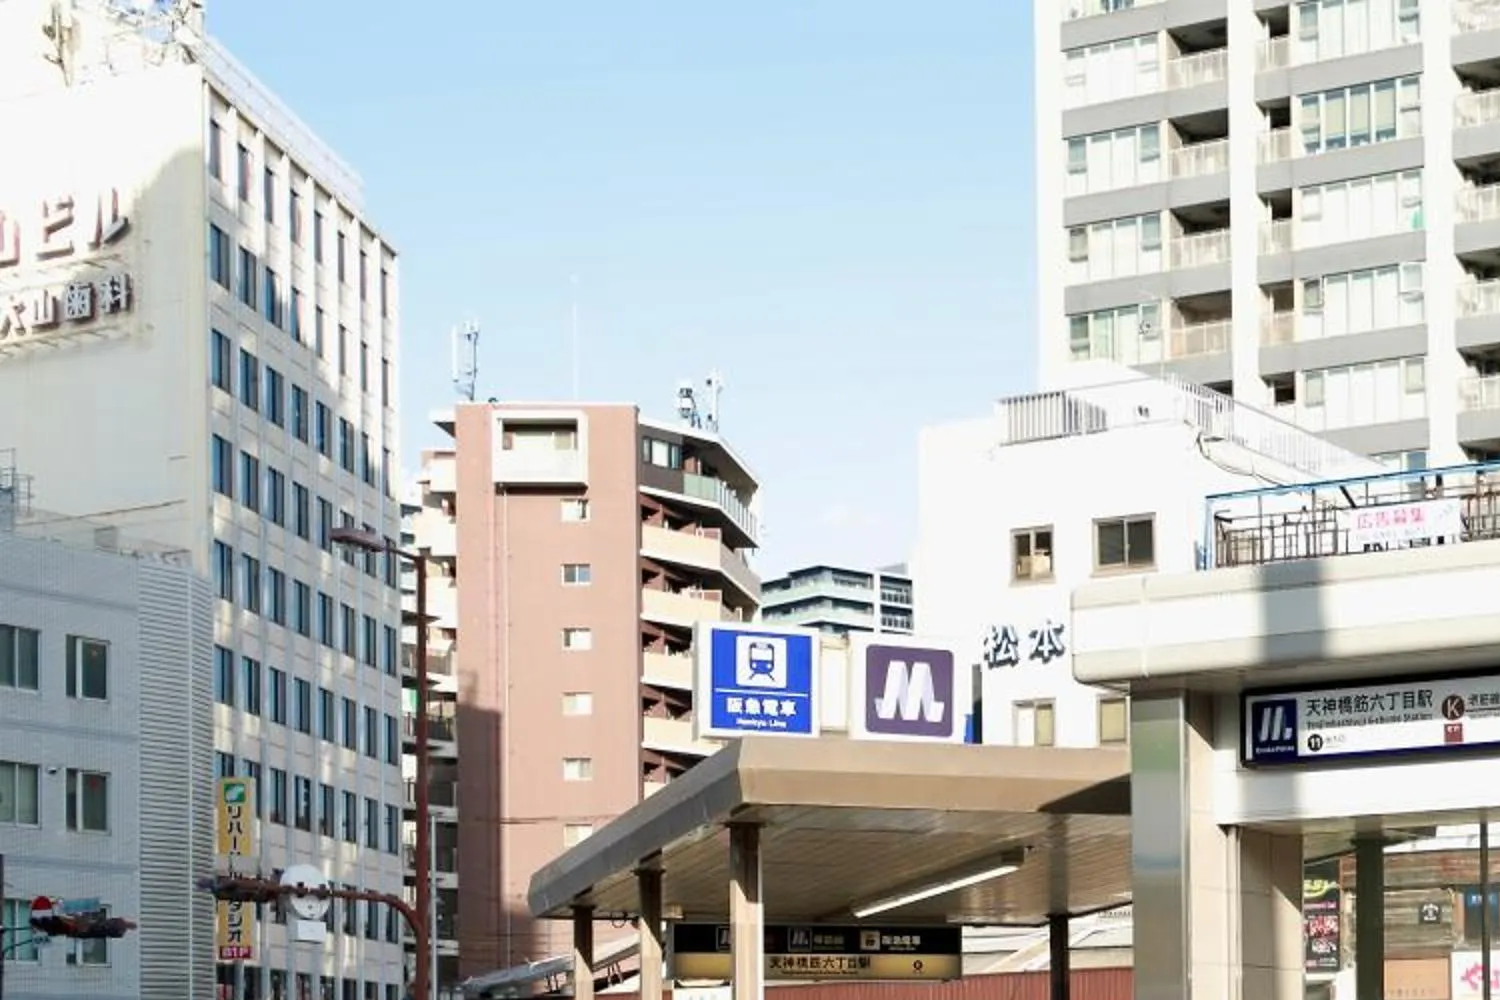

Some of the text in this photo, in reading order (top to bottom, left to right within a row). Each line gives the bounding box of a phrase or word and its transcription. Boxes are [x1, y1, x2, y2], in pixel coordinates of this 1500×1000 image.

[983, 620, 1066, 668] 松本
[1305, 689, 1433, 717] 天神橋筋六丁目駅
